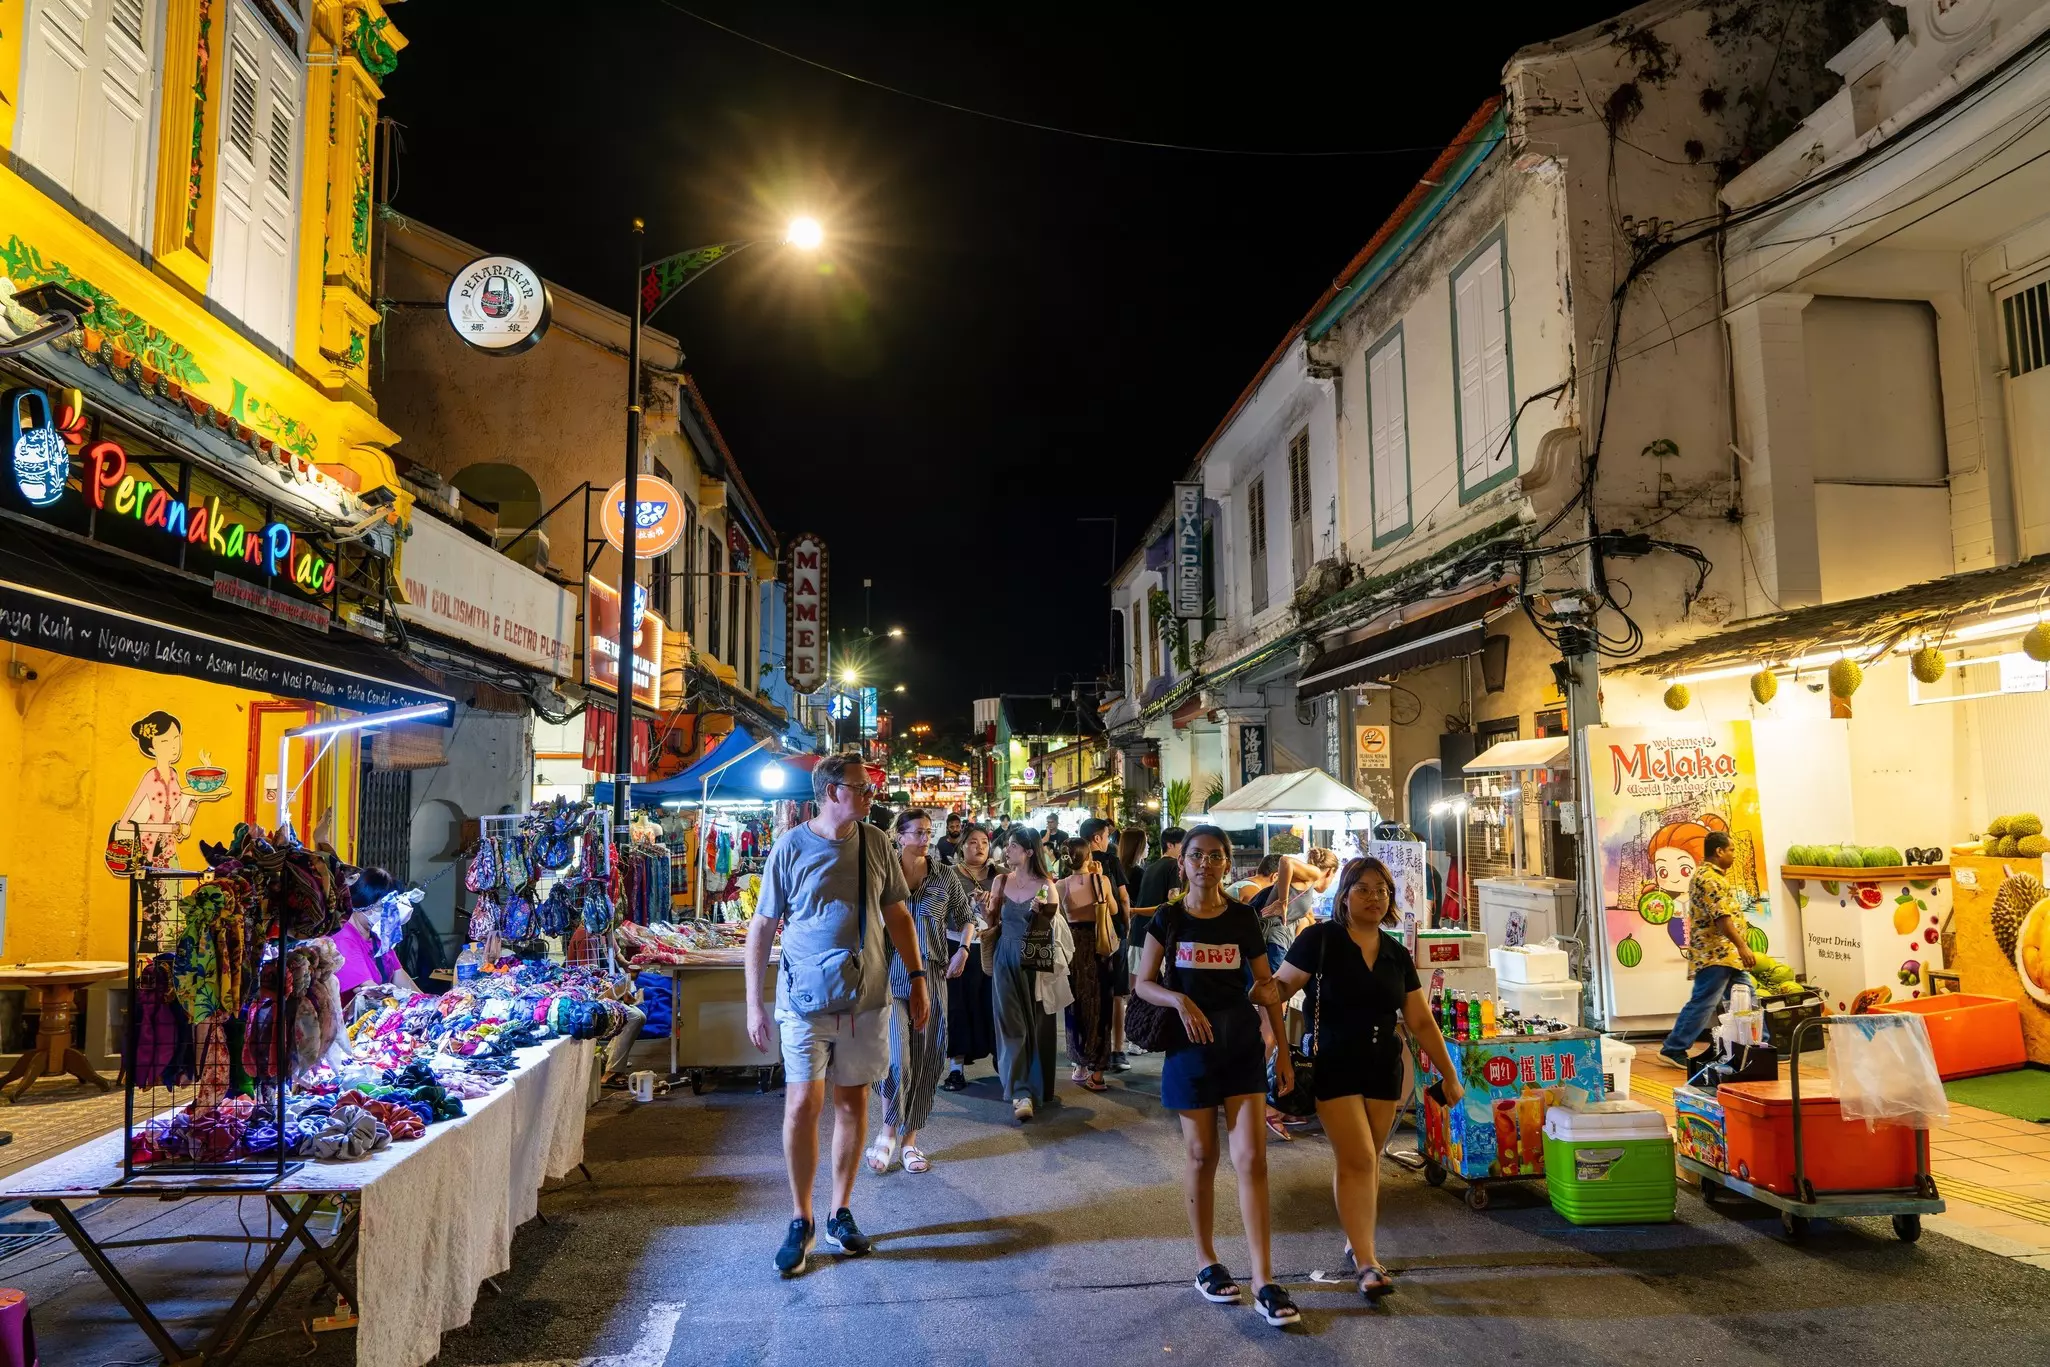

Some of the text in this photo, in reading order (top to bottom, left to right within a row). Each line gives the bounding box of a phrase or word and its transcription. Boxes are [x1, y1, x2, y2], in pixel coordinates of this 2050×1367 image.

[461, 265, 533, 299] PERANAKAN
[88, 441, 336, 594] Peranakan Place
[1180, 488, 1198, 613] ROYAL PRESS
[432, 589, 490, 630] GOLDSMITH
[494, 615, 500, 637] &
[504, 619, 538, 652] ELECTRO
[796, 552, 818, 674] MAMEE
[38, 612, 74, 641] Kuih
[98, 628, 150, 662] Nyonya
[155, 640, 191, 664] Laksa
[206, 653, 238, 675] Asam
[240, 660, 269, 683] Laksa
[282, 671, 302, 690] Nasi
[1244, 727, 1263, 784] 洛陽
[1608, 743, 1735, 794] Melaka
[1652, 737, 1713, 748] welcome to
[1627, 784, 1659, 795] World
[1709, 780, 1733, 791] City
[1808, 932, 1861, 948] Yogurt Drinks
[1488, 1053, 1577, 1083] 网红 摇摇冰
